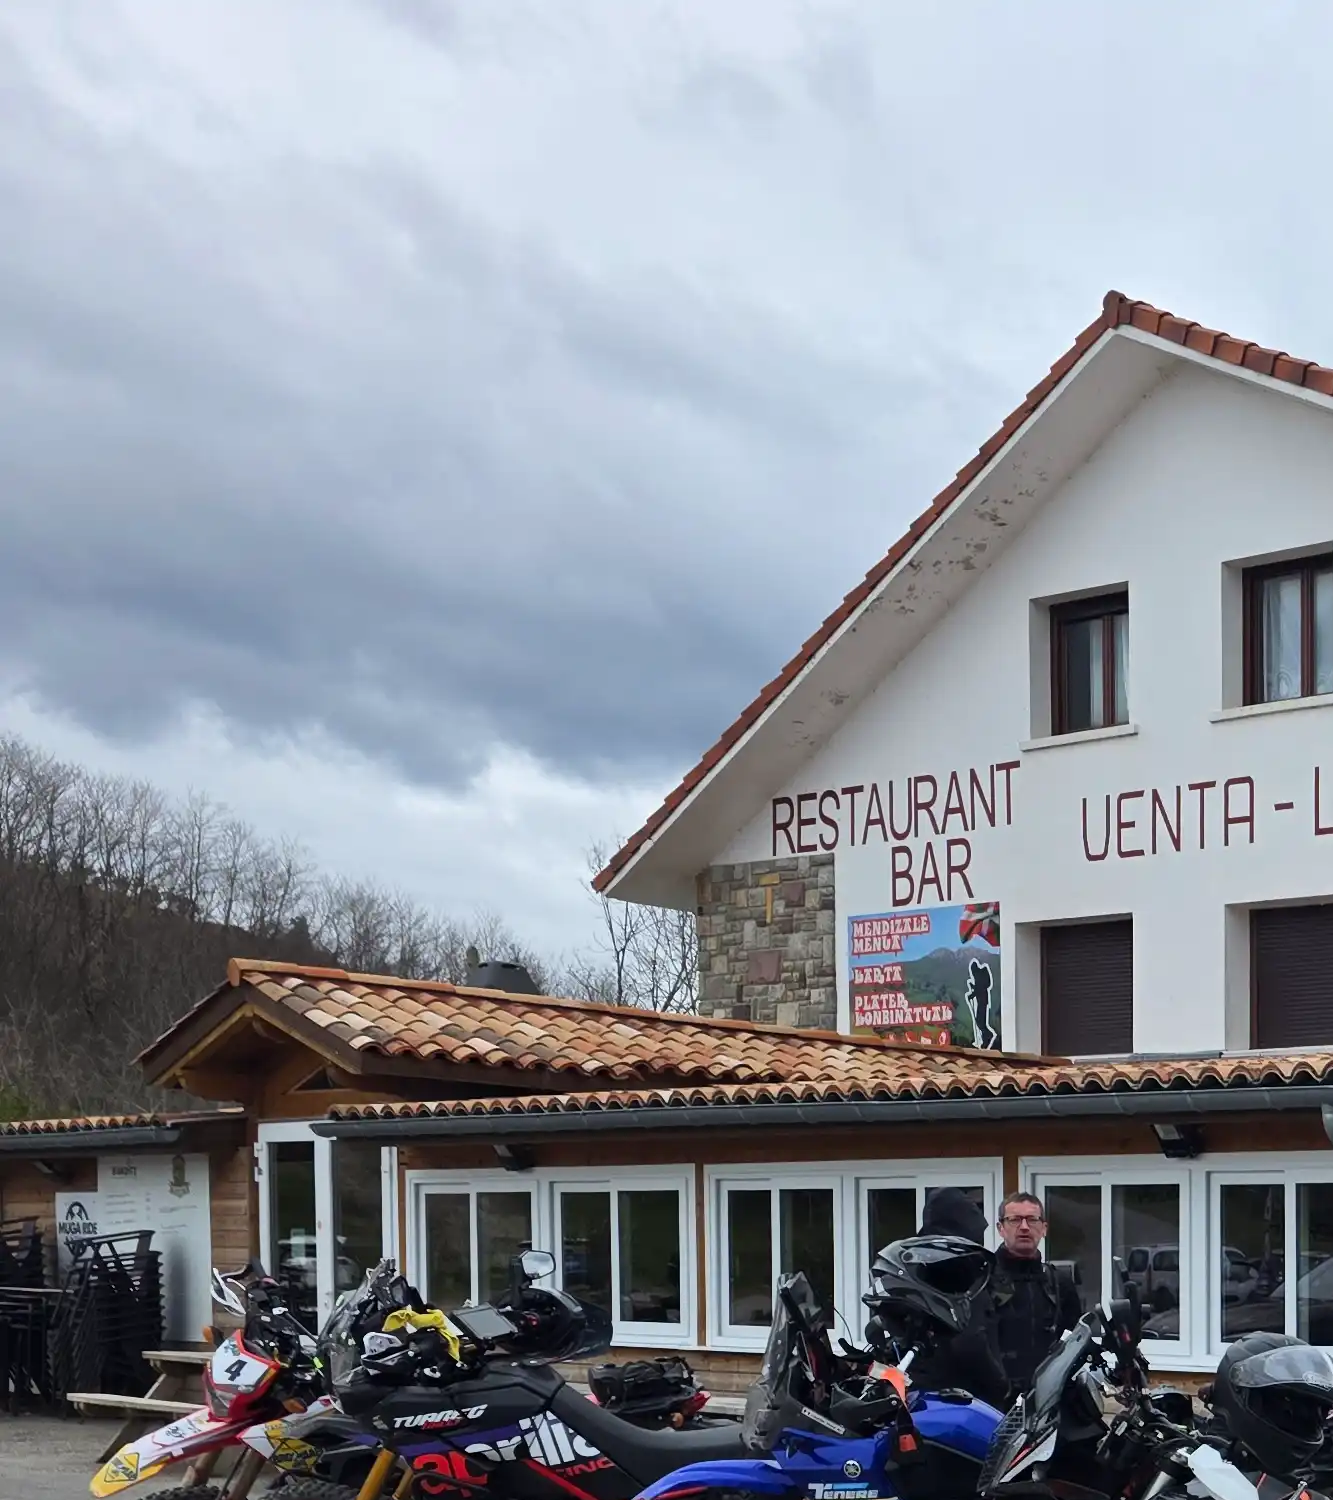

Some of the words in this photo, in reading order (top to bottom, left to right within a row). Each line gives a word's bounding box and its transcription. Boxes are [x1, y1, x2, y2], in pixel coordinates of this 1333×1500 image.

[772, 760, 1020, 856] RESTAURANT
[891, 837, 974, 907] BAR
[224, 1358, 248, 1381] 4
